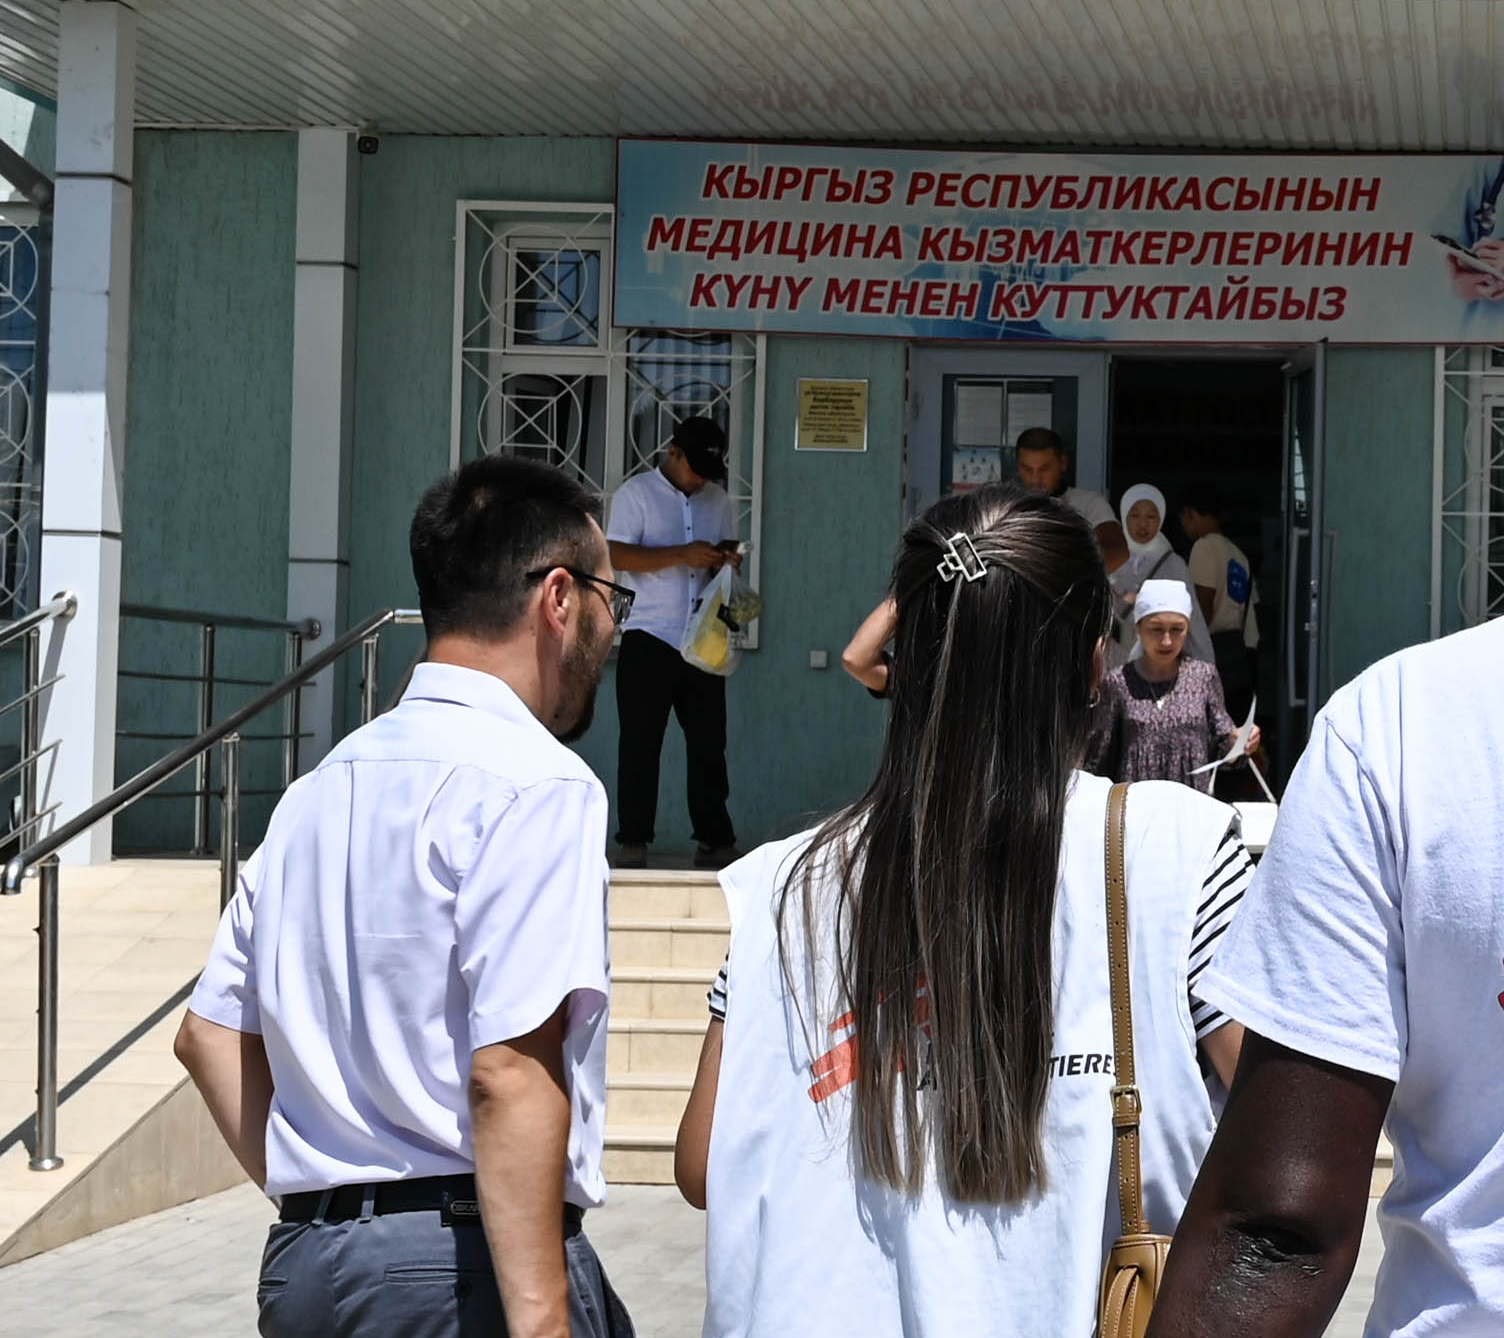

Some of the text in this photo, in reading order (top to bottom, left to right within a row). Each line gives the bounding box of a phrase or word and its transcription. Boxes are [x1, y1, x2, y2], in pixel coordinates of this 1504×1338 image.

[700, 163, 1382, 212] КЫРГЫЗ РЕСПУБЛИКАСЫНЫН
[646, 217, 1414, 267] МЕДИЦИНА КЫЗМАТКЕРЛЕРИНИН
[689, 273, 1348, 321] КҮНҮ МЕНЕН КУТТУКТАЙБЫЗ
